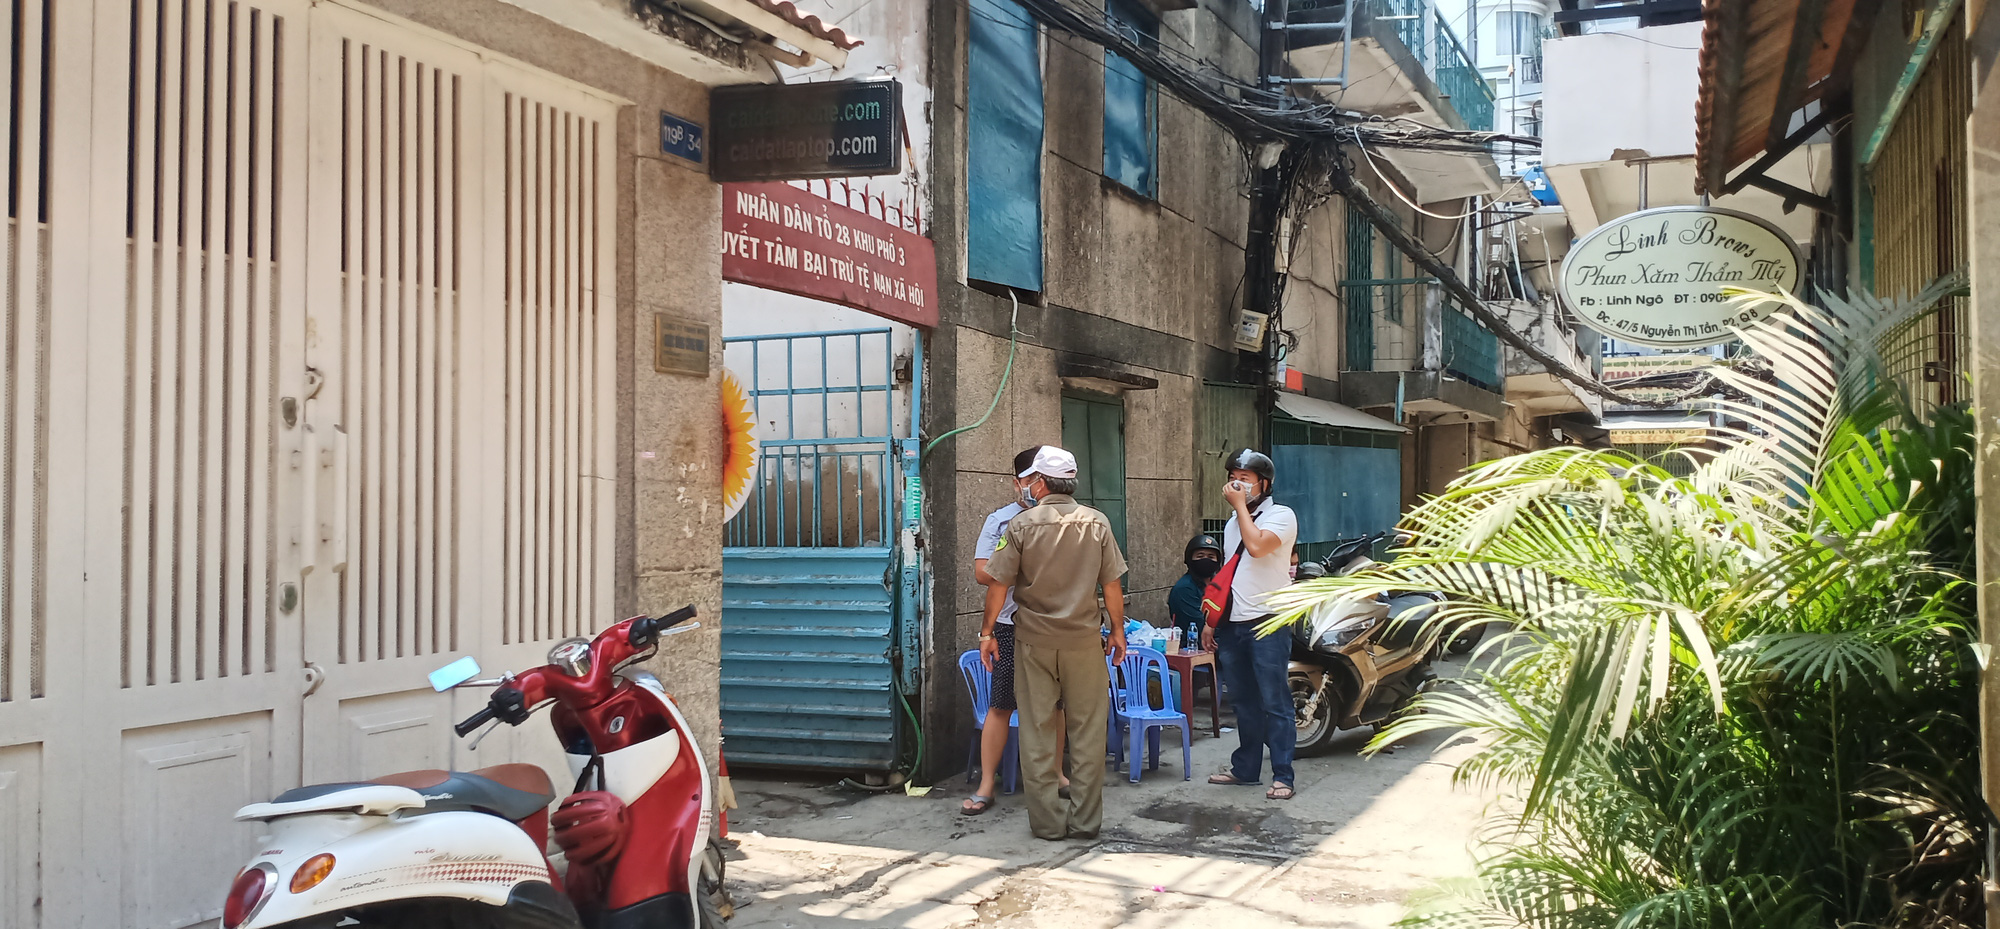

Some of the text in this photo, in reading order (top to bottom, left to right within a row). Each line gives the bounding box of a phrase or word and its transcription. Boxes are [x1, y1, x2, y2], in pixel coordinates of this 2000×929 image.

[737, 190, 905, 267] NHÂN DÂN TỔ 28 KHU PHỐ 3
[1604, 216, 1758, 261] Linh Brows
[764, 236, 798, 270] TÂM
[803, 250, 827, 280] BẠI
[830, 255, 855, 284] TRỪ
[856, 264, 870, 293] TỆ
[873, 271, 892, 299] NẠN
[894, 277, 906, 302] XÃ
[908, 283, 924, 311] HỘI
[1574, 259, 1787, 287] Phun Xăm Thẩm Mỹ
[1607, 295, 1632, 305] Linh
[1636, 294, 1664, 307] Ngô
[1674, 294, 1690, 304] ĐT
[1616, 318, 1639, 333] 47/5
[1640, 323, 1681, 338] Nguyễn
[1683, 326, 1698, 338] Thị
